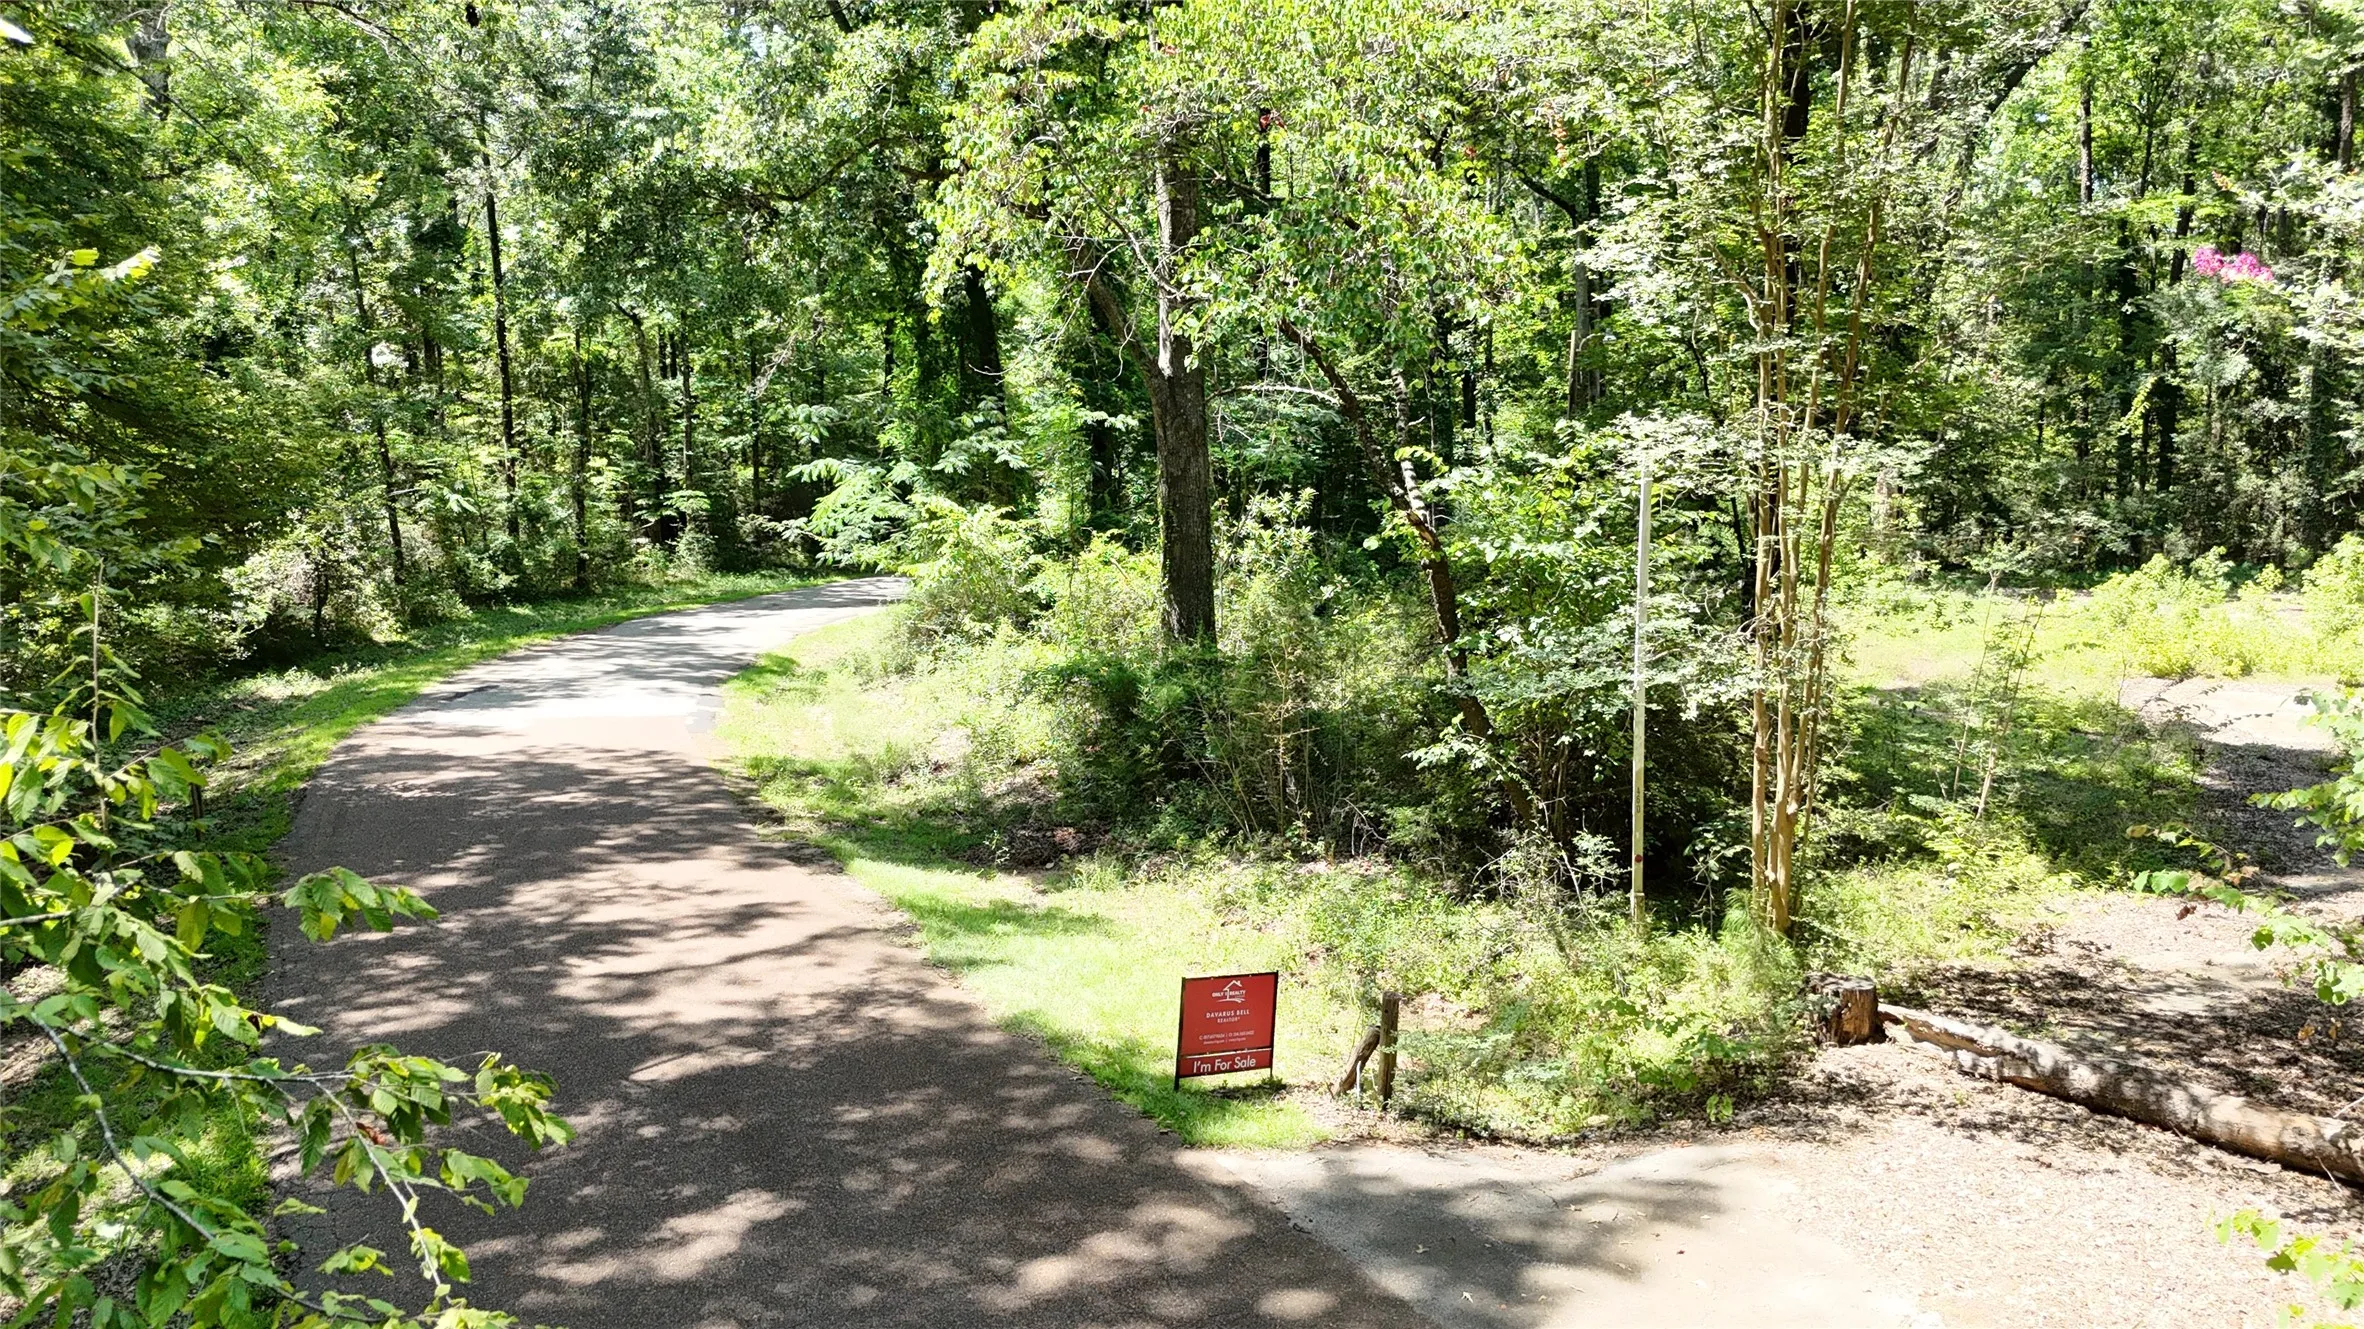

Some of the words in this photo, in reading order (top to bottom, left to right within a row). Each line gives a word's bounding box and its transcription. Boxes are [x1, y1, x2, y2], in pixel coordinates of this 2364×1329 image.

[1206, 1010, 1235, 1019] DAVARUS
[1214, 1058, 1232, 1071] For
[1233, 1054, 1256, 1069] Sale
